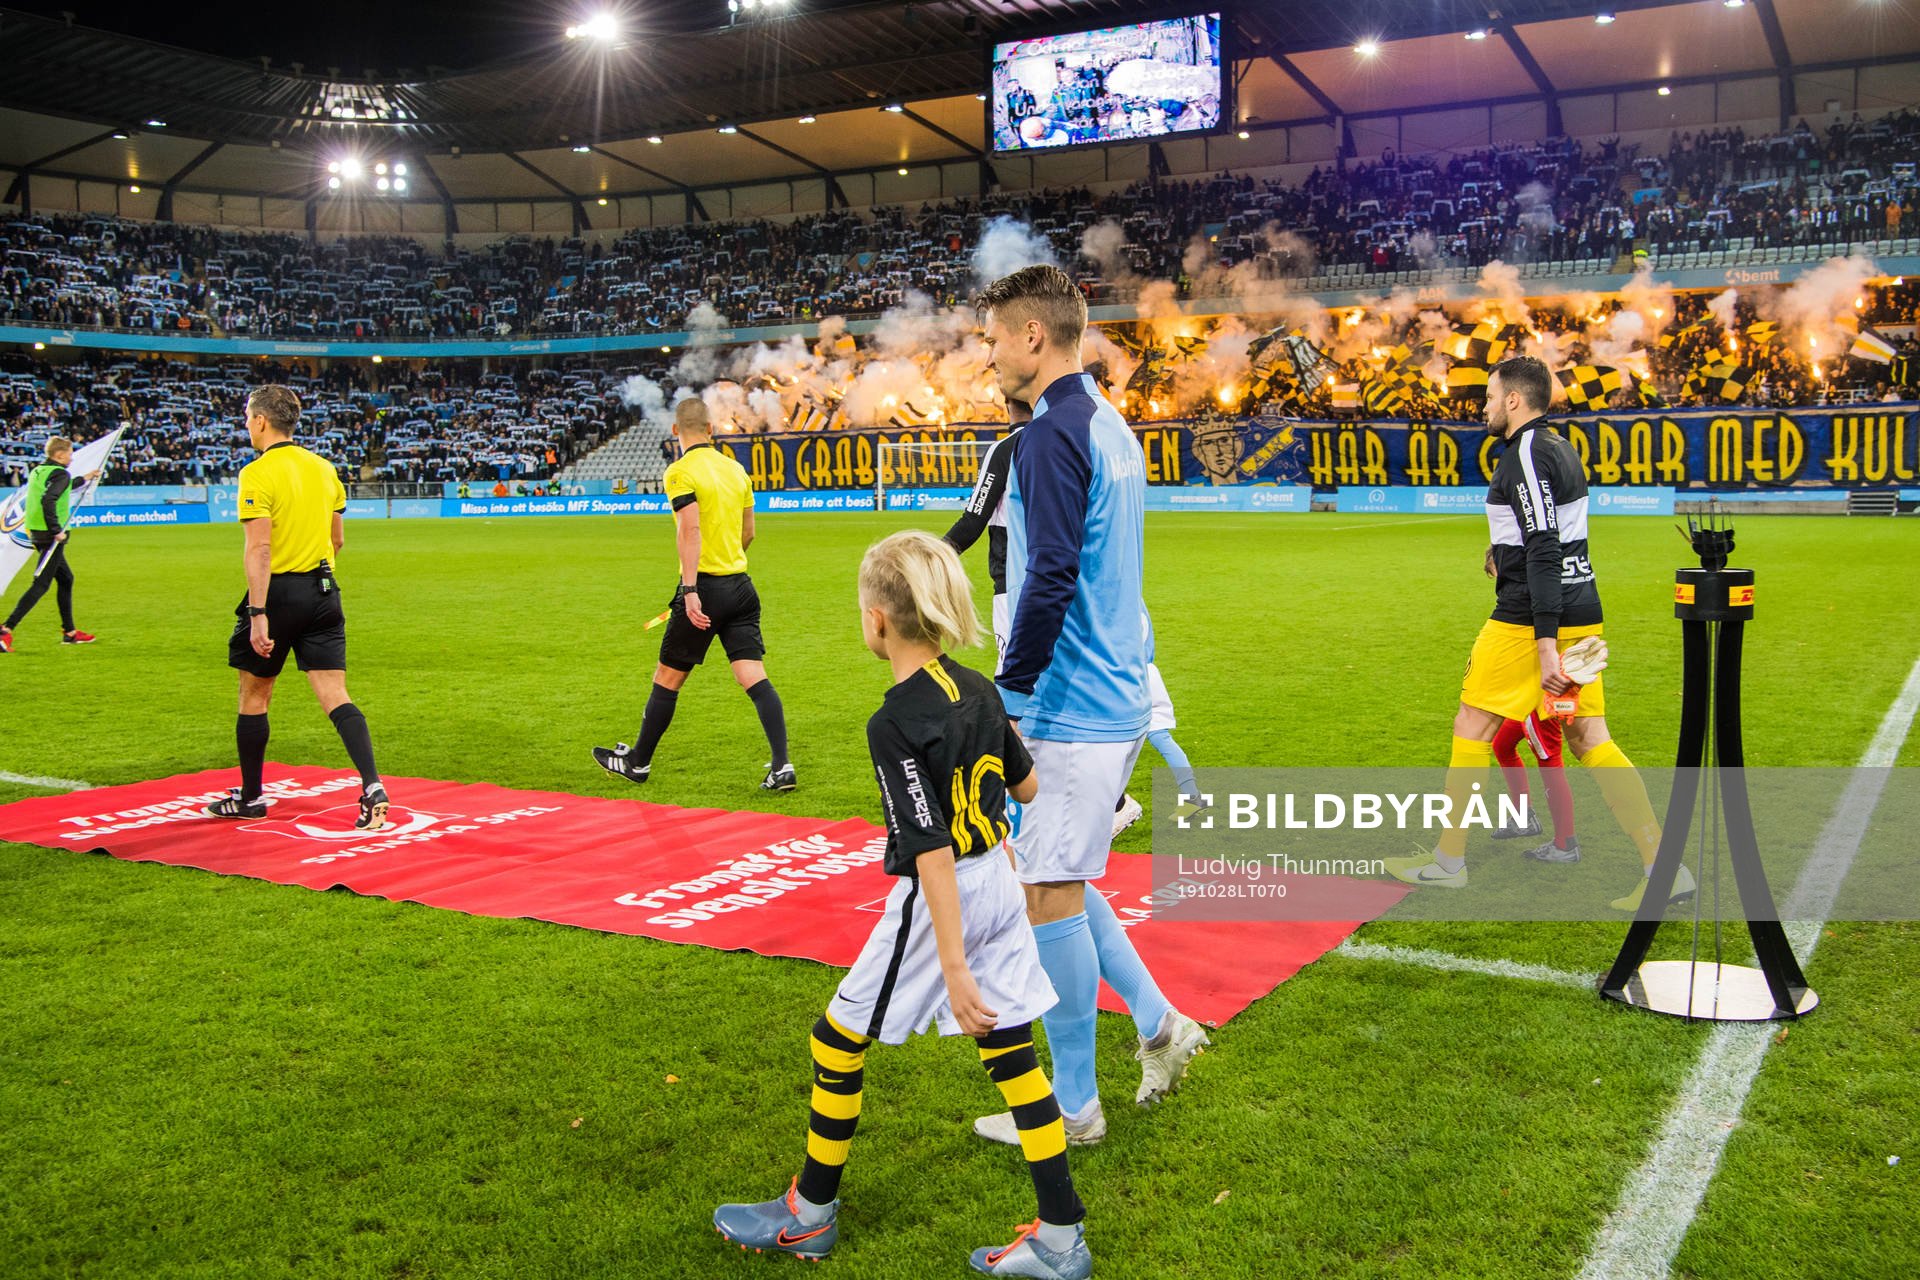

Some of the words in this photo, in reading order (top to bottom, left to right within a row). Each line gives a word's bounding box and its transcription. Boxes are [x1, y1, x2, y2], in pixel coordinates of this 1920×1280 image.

[1741, 269, 1780, 283] bemt
[750, 436, 786, 491] ÄR
[1309, 423, 1387, 486] HÄR
[1405, 423, 1459, 486] ÄR
[1708, 415, 1804, 482] MED
[1825, 415, 1919, 481] KUL
[100, 511, 126, 523] efter
[129, 509, 178, 523] matchen!
[461, 502, 489, 514] Missa
[490, 502, 509, 514] inte
[511, 503, 527, 513] att
[528, 501, 565, 513] besöka
[567, 500, 590, 512] MFF
[591, 500, 632, 514] Shopen
[633, 499, 660, 512] efter
[769, 496, 799, 509] Missa
[802, 496, 824, 509] inte
[826, 497, 844, 508] att
[846, 495, 874, 508] besö
[973, 472, 996, 516] stadium
[1266, 491, 1294, 503] bemt
[1516, 482, 1537, 533] stadium
[1539, 480, 1557, 529] stadium
[473, 805, 564, 825] SPEL
[900, 758, 933, 828] stadium
[614, 851, 793, 909] Framåt
